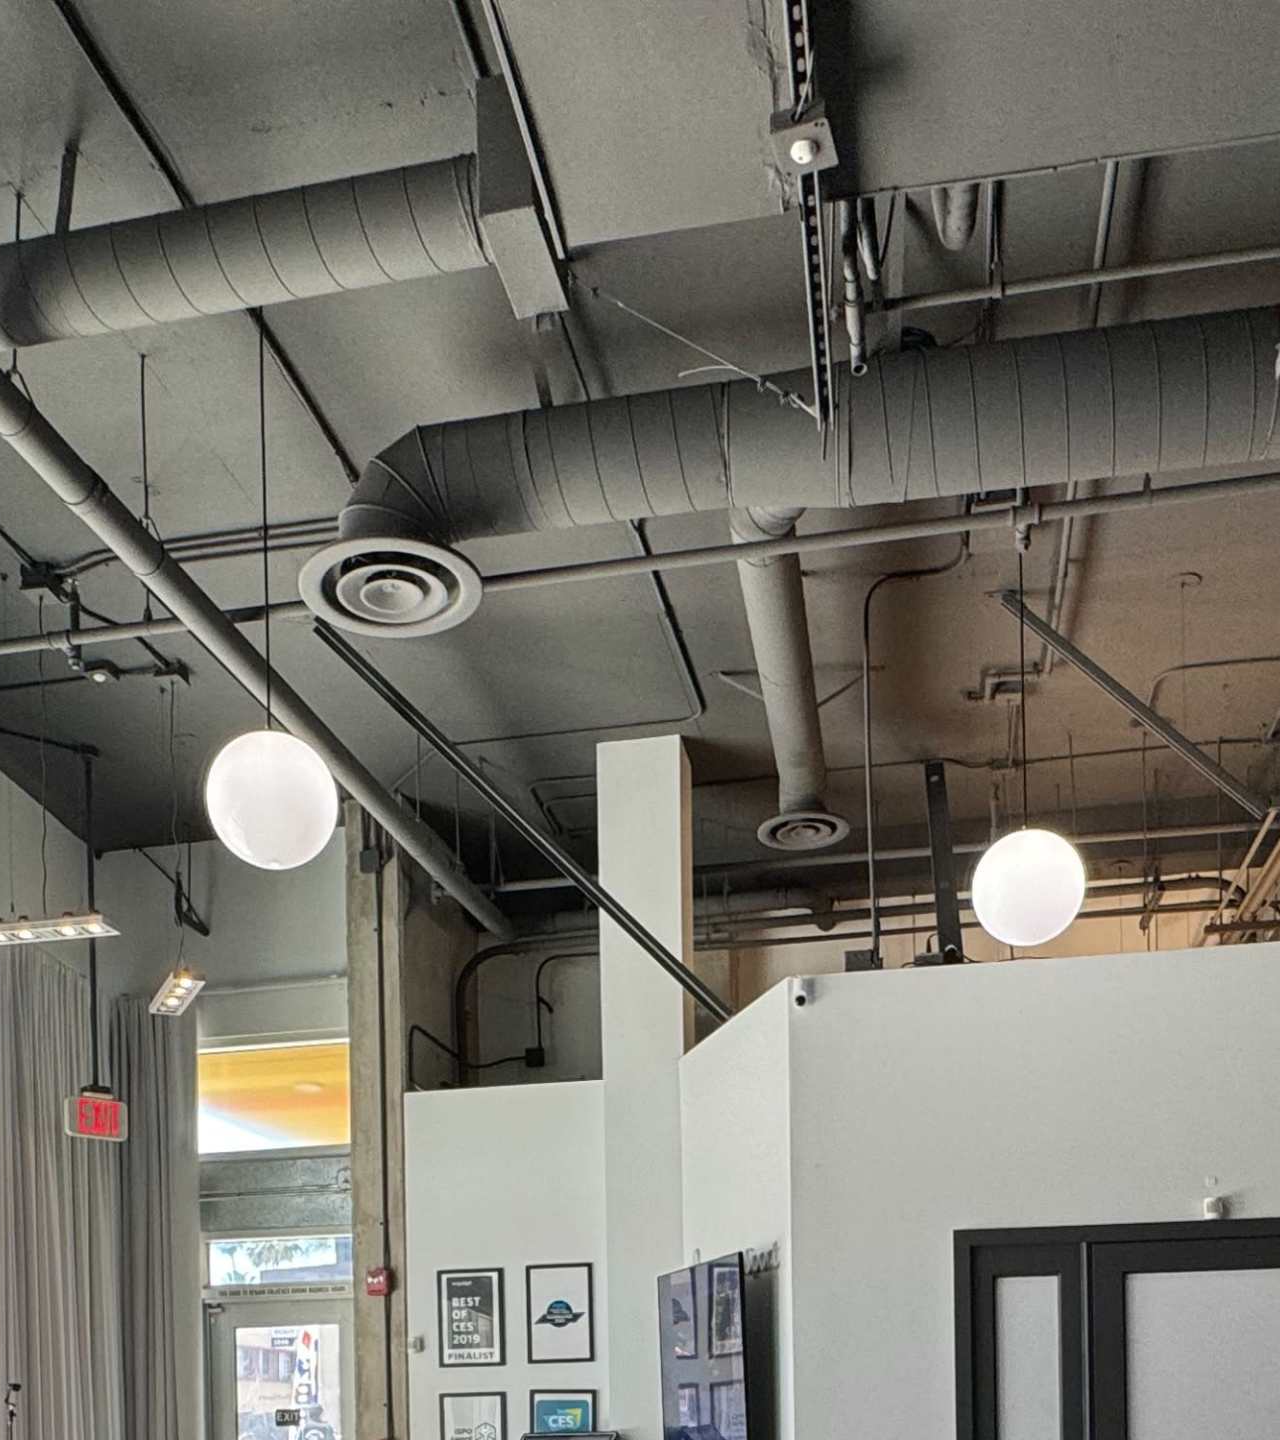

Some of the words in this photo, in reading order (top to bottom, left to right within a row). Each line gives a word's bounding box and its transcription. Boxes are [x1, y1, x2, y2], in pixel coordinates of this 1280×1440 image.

[78, 1099, 120, 1136] EXIT
[452, 1297, 480, 1307] BEST
[452, 1309, 468, 1320] OF
[452, 1321, 475, 1332] CES
[453, 1334, 481, 1345] 2019
[448, 1352, 495, 1360] FINALIST
[277, 1413, 300, 1422] EXIT
[548, 1415, 575, 1428] CES
